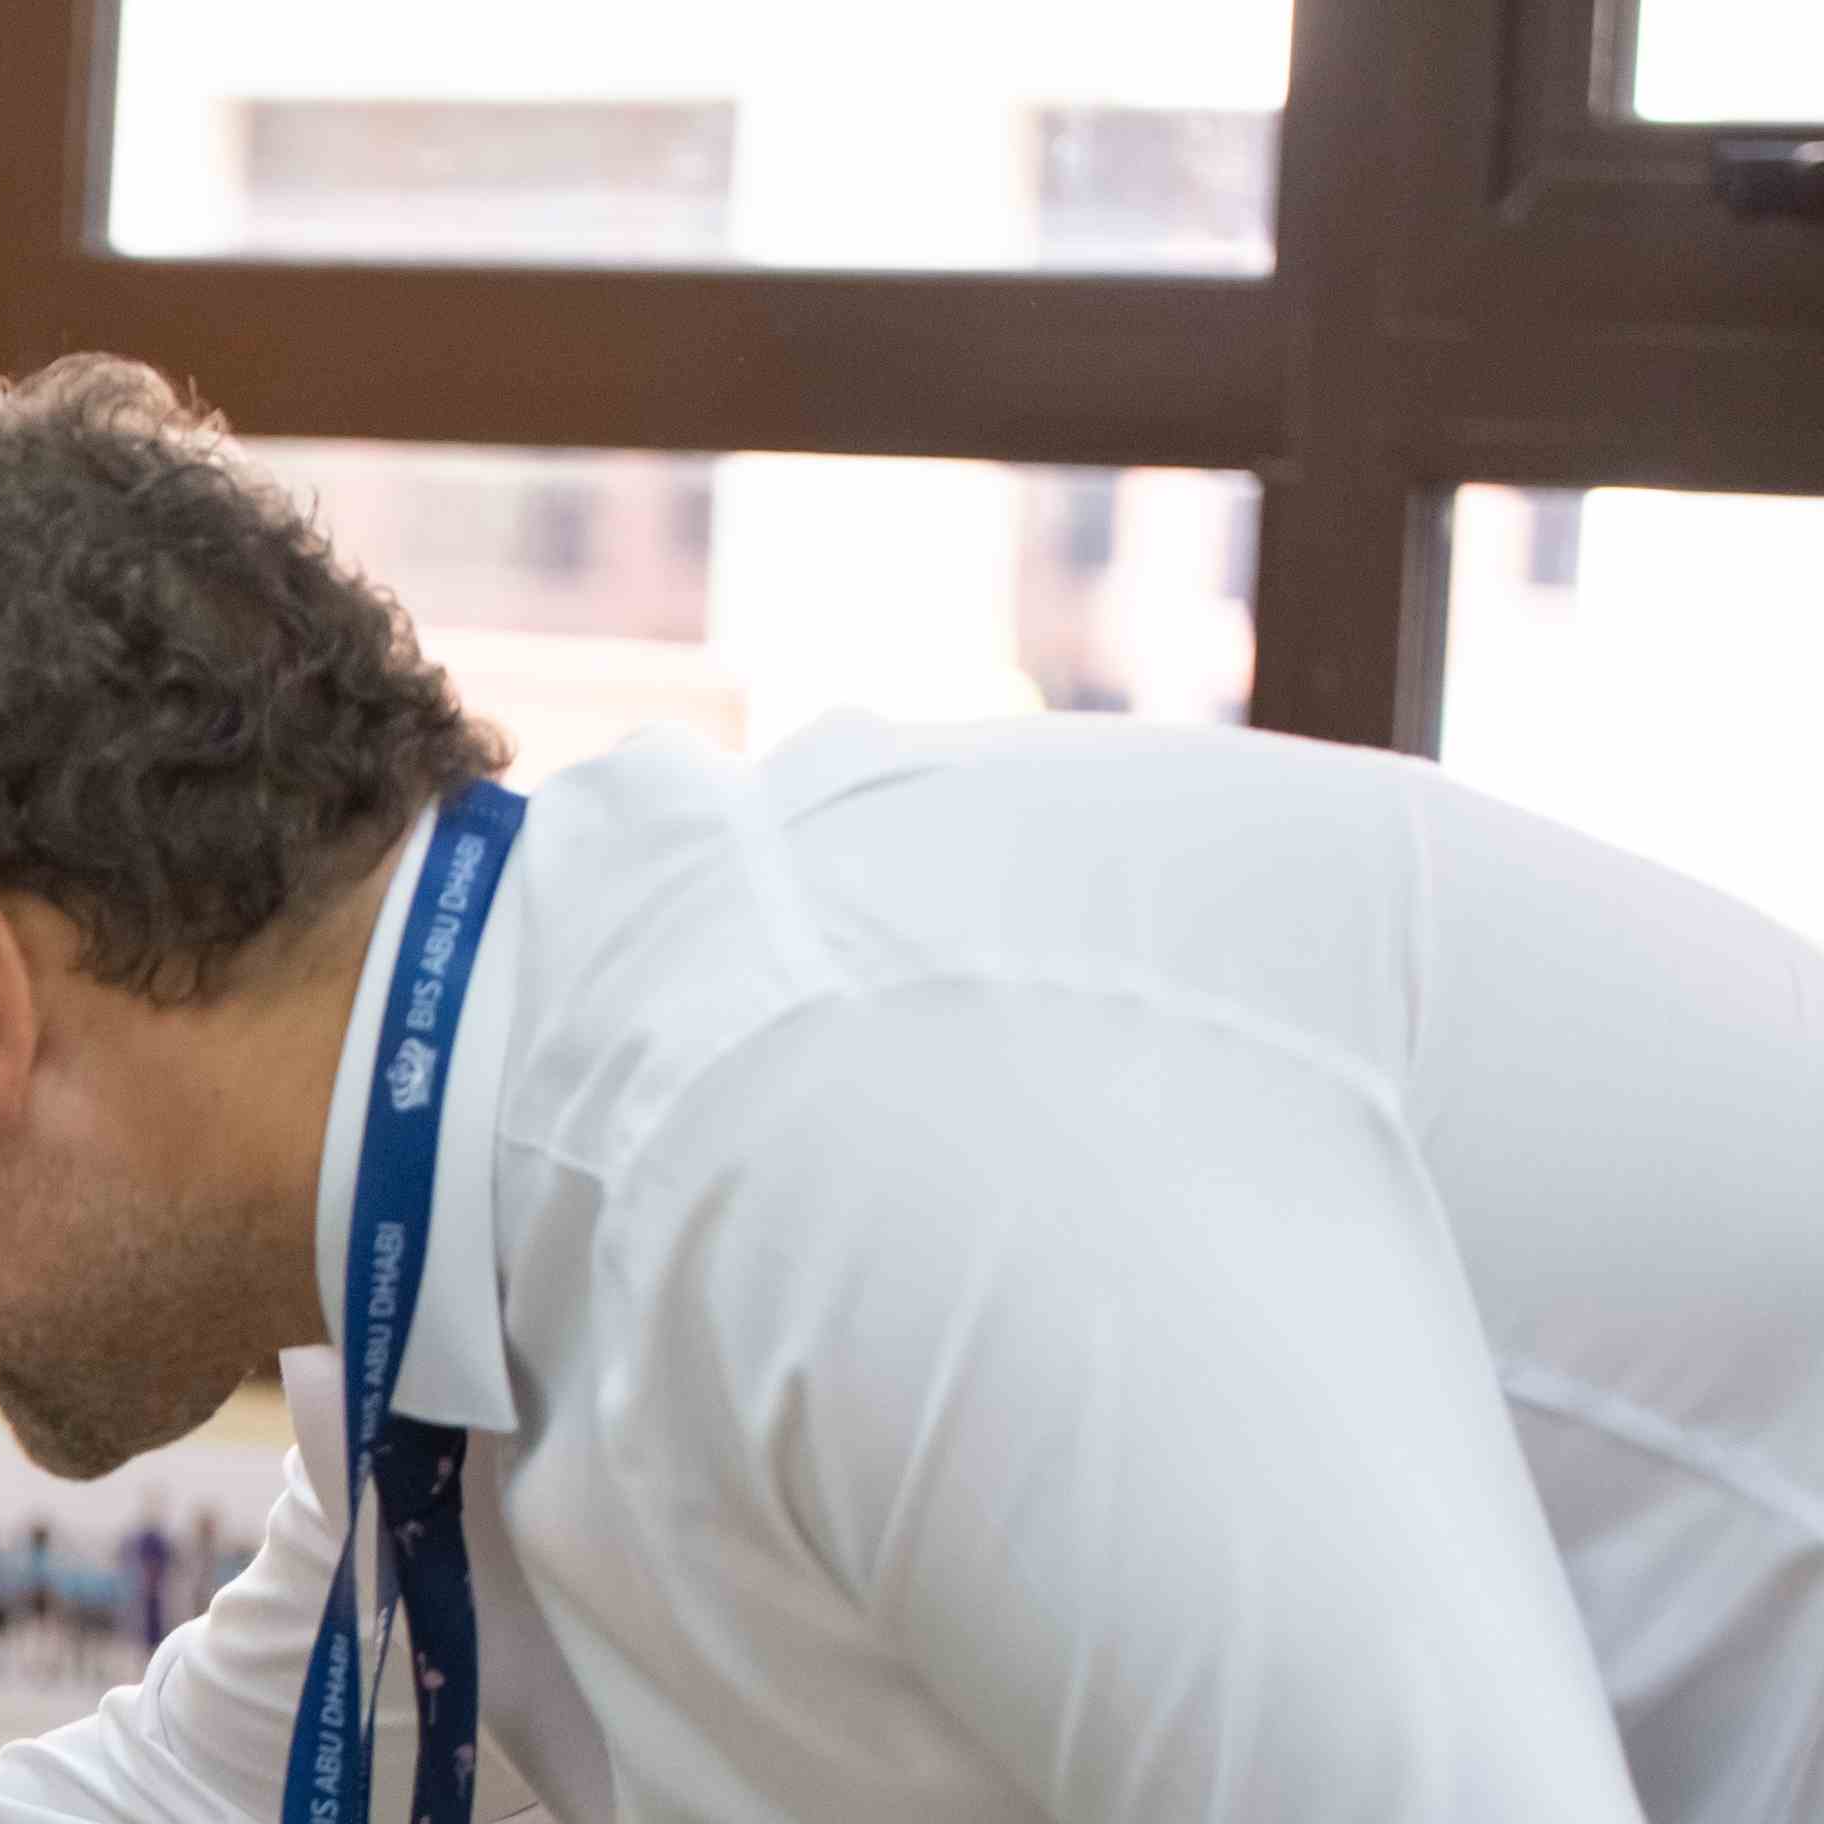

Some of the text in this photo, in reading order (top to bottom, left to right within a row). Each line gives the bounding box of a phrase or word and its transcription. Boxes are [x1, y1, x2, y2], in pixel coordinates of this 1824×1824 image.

[419, 913, 461, 977] ABU
[405, 978, 443, 1031] BIS
[368, 1221, 404, 1318] DHABI
[363, 1322, 393, 1387] ABU
[314, 1730, 344, 1796] ABU
